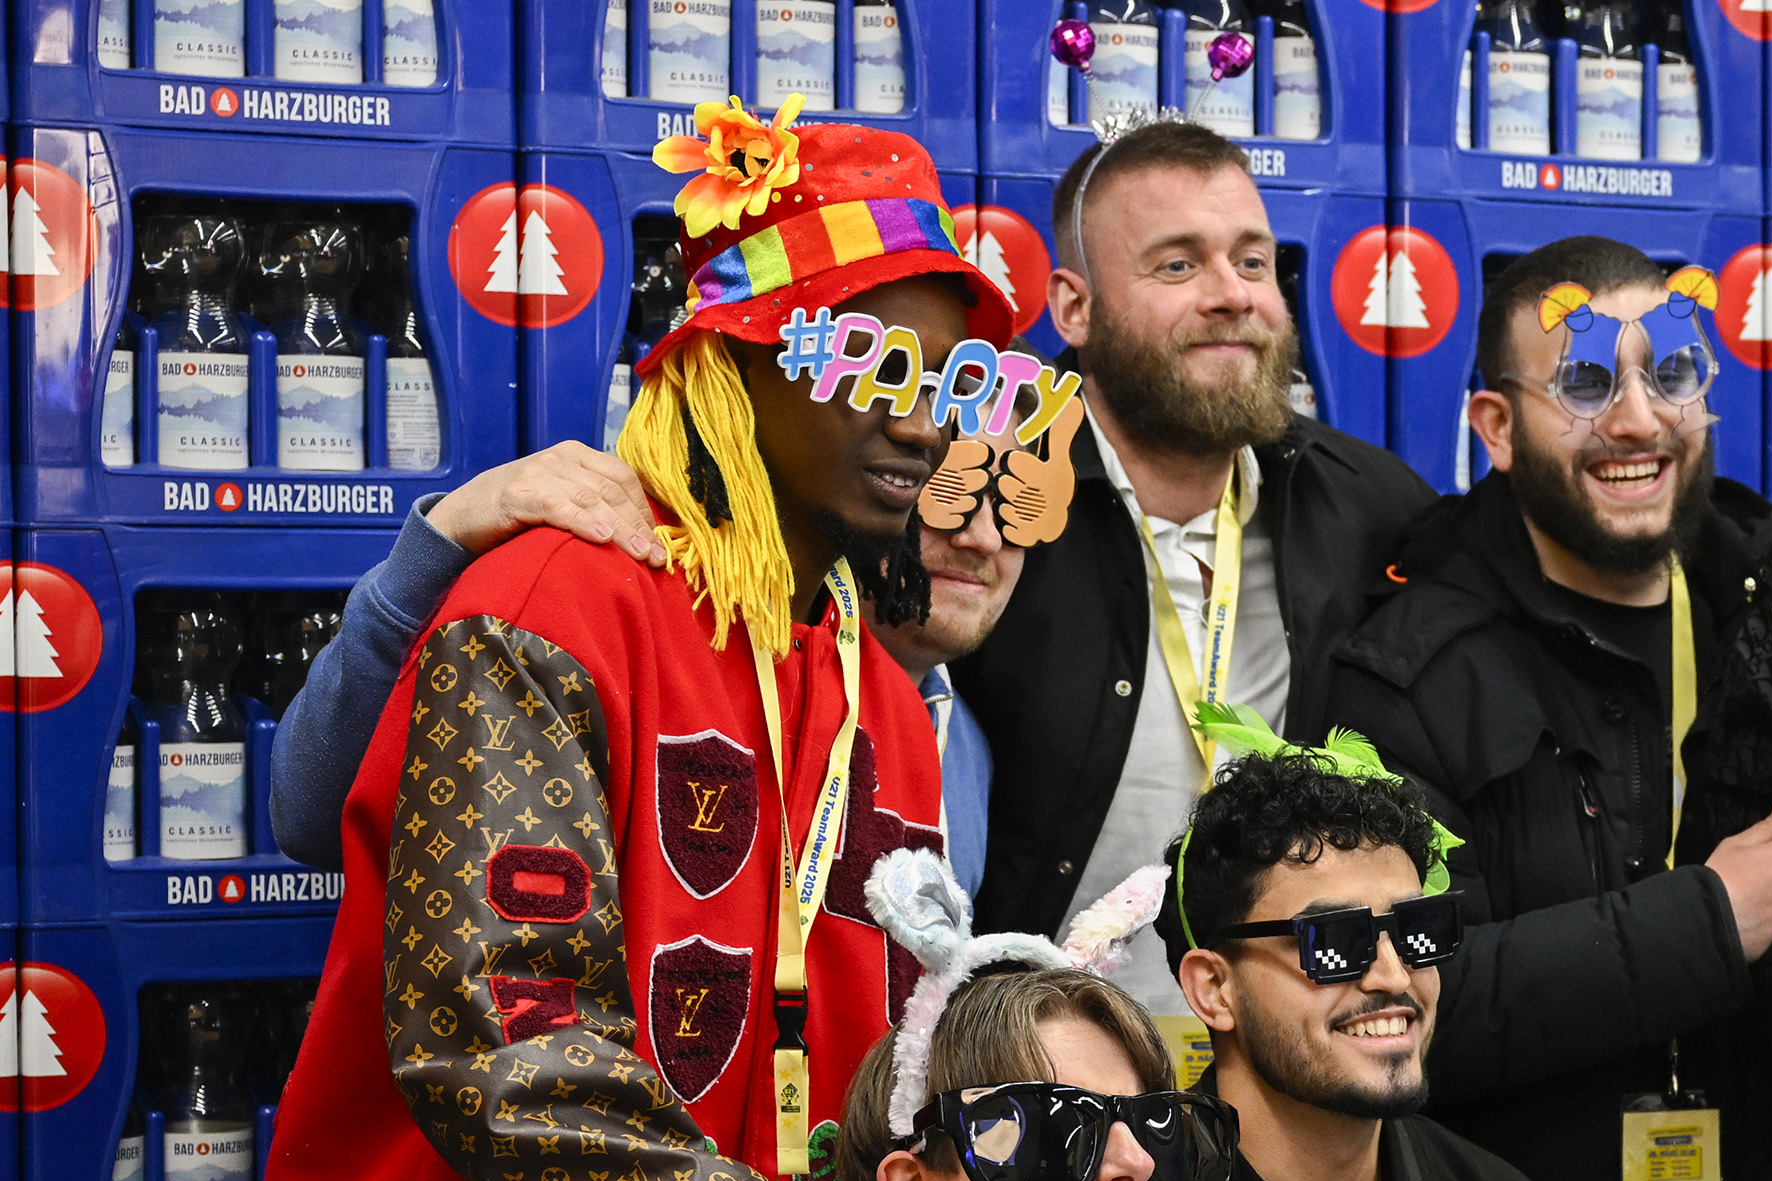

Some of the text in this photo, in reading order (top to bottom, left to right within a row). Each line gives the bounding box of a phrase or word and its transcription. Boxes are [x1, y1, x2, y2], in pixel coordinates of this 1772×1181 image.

[653, 1, 672, 13] BAD
[759, 10, 778, 22] BAD
[862, 16, 882, 28] BAD
[176, 42, 237, 54] CLASSIC
[292, 49, 353, 61] CLASSIC
[670, 71, 725, 83] CLASSIC
[777, 78, 831, 90] CLASSIC
[160, 84, 391, 126] BAD HARZBURGER
[657, 112, 699, 140] BAD
[1502, 161, 1673, 197] BAD HARZBURGER
[162, 363, 181, 376] BAD
[307, 365, 363, 380] HARZBURGER
[777, 307, 1082, 446] #PARTY
[180, 436, 240, 447] CLASSIC
[290, 436, 352, 447] CLASSIC
[164, 481, 394, 514] BAD HARZBURGER
[839, 588, 853, 619] 2025
[1216, 604, 1227, 621] U21
[1208, 624, 1224, 689] TeamAward
[185, 752, 243, 767] HARZBURGER
[168, 826, 232, 836] CLASSIC
[800, 776, 841, 905] U21 TeamAward 2025
[167, 876, 213, 904] BAD
[174, 1142, 194, 1156] BAD
